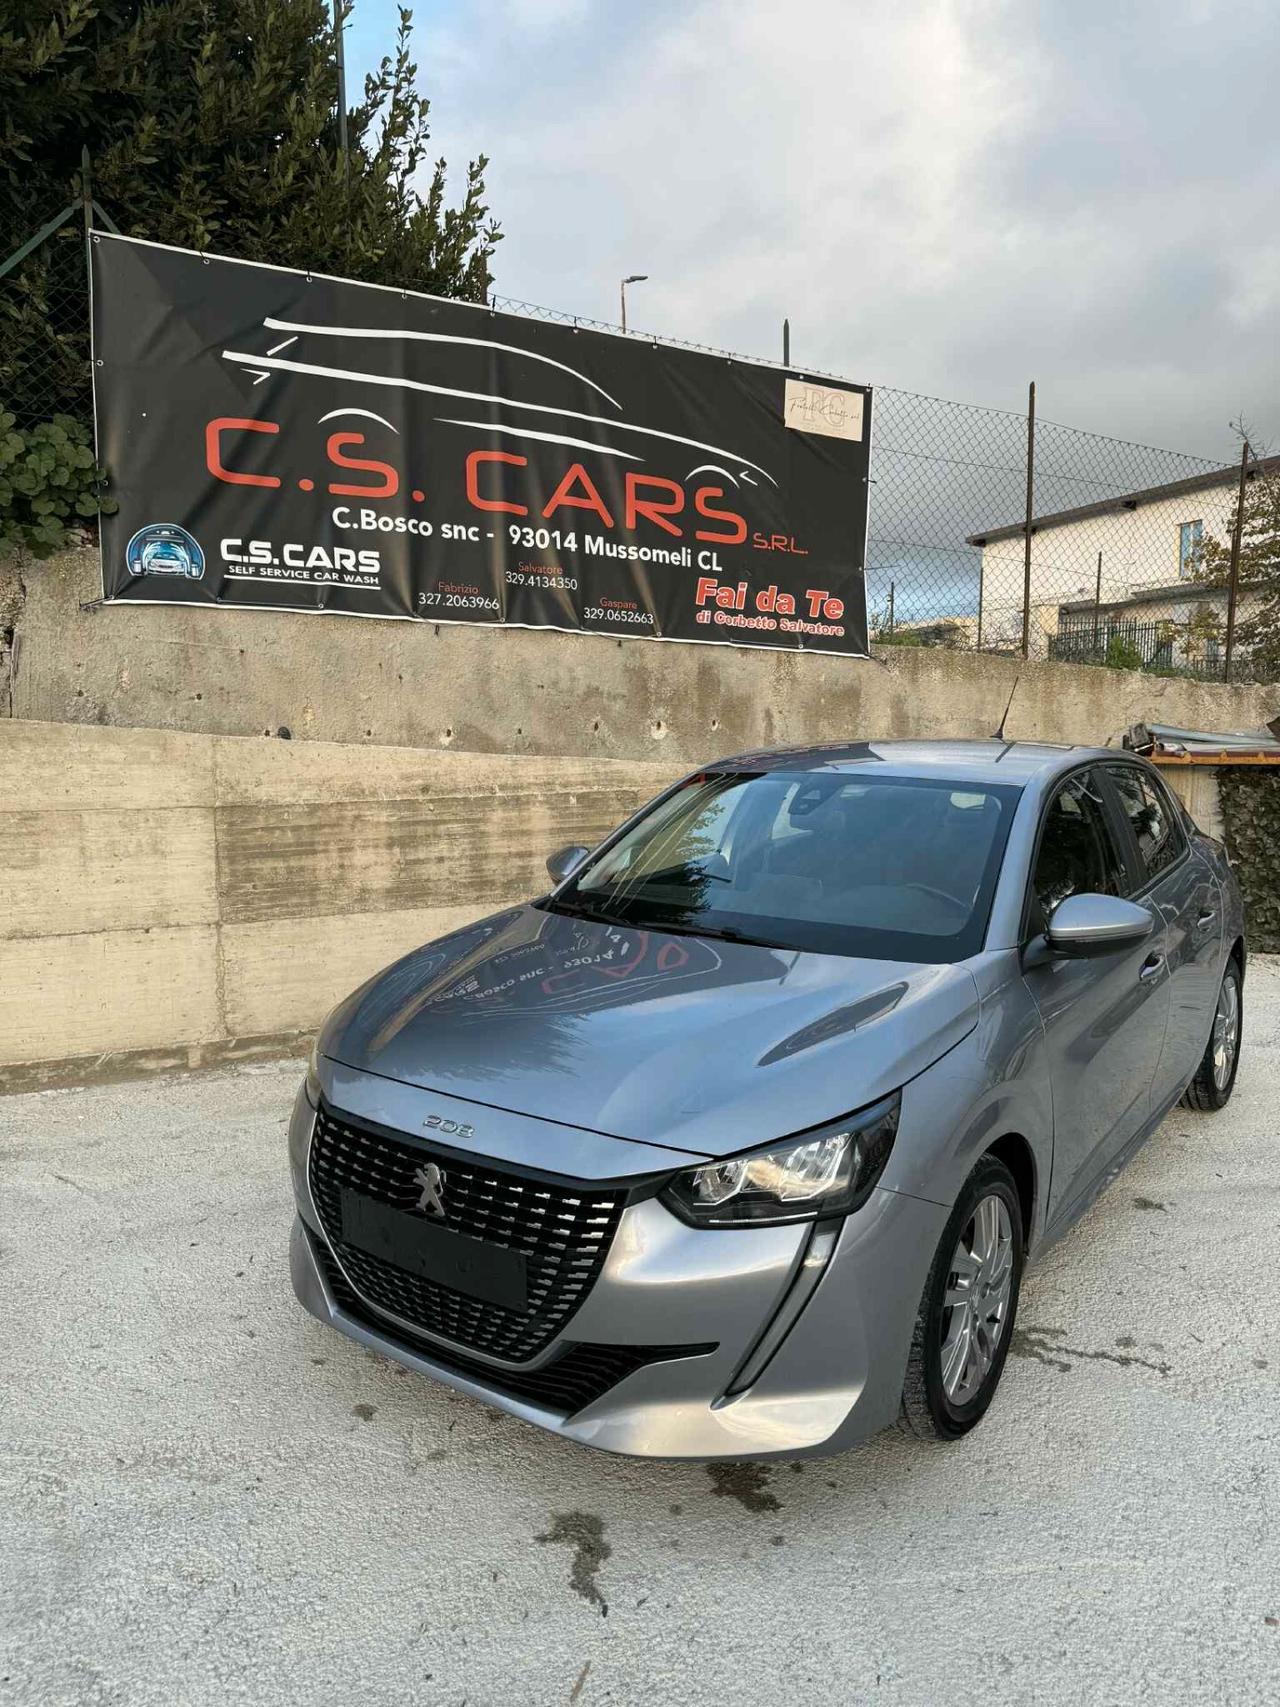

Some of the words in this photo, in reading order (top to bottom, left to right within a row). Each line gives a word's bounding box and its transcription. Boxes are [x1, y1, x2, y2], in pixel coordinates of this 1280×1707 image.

[465, 450, 747, 545] CARS
[332, 506, 433, 537] C.Bosco
[440, 522, 480, 541] snc
[508, 524, 578, 552] 93014
[584, 534, 692, 567] Mussomeli
[697, 550, 723, 572] CL
[220, 538, 381, 573] C.S.CARS
[228, 565, 256, 575] SELF
[260, 567, 310, 579] SERVICE
[314, 572, 340, 581] CAR
[343, 574, 379, 585] WASH
[518, 561, 563, 575] Salvatore
[438, 581, 480, 595] Fabrizio
[505, 571, 578, 590] 329.4134350
[418, 592, 500, 610] 327.2063966
[600, 596, 637, 611] Gaspare
[695, 577, 748, 610] Fai
[755, 585, 796, 615] da
[805, 589, 845, 620] Te
[583, 607, 654, 625] 329.0652663
[695, 610, 711, 624] di
[714, 610, 777, 631] Corbetto
[779, 618, 845, 637] Salvatore
[422, 1114, 476, 1139] 208
